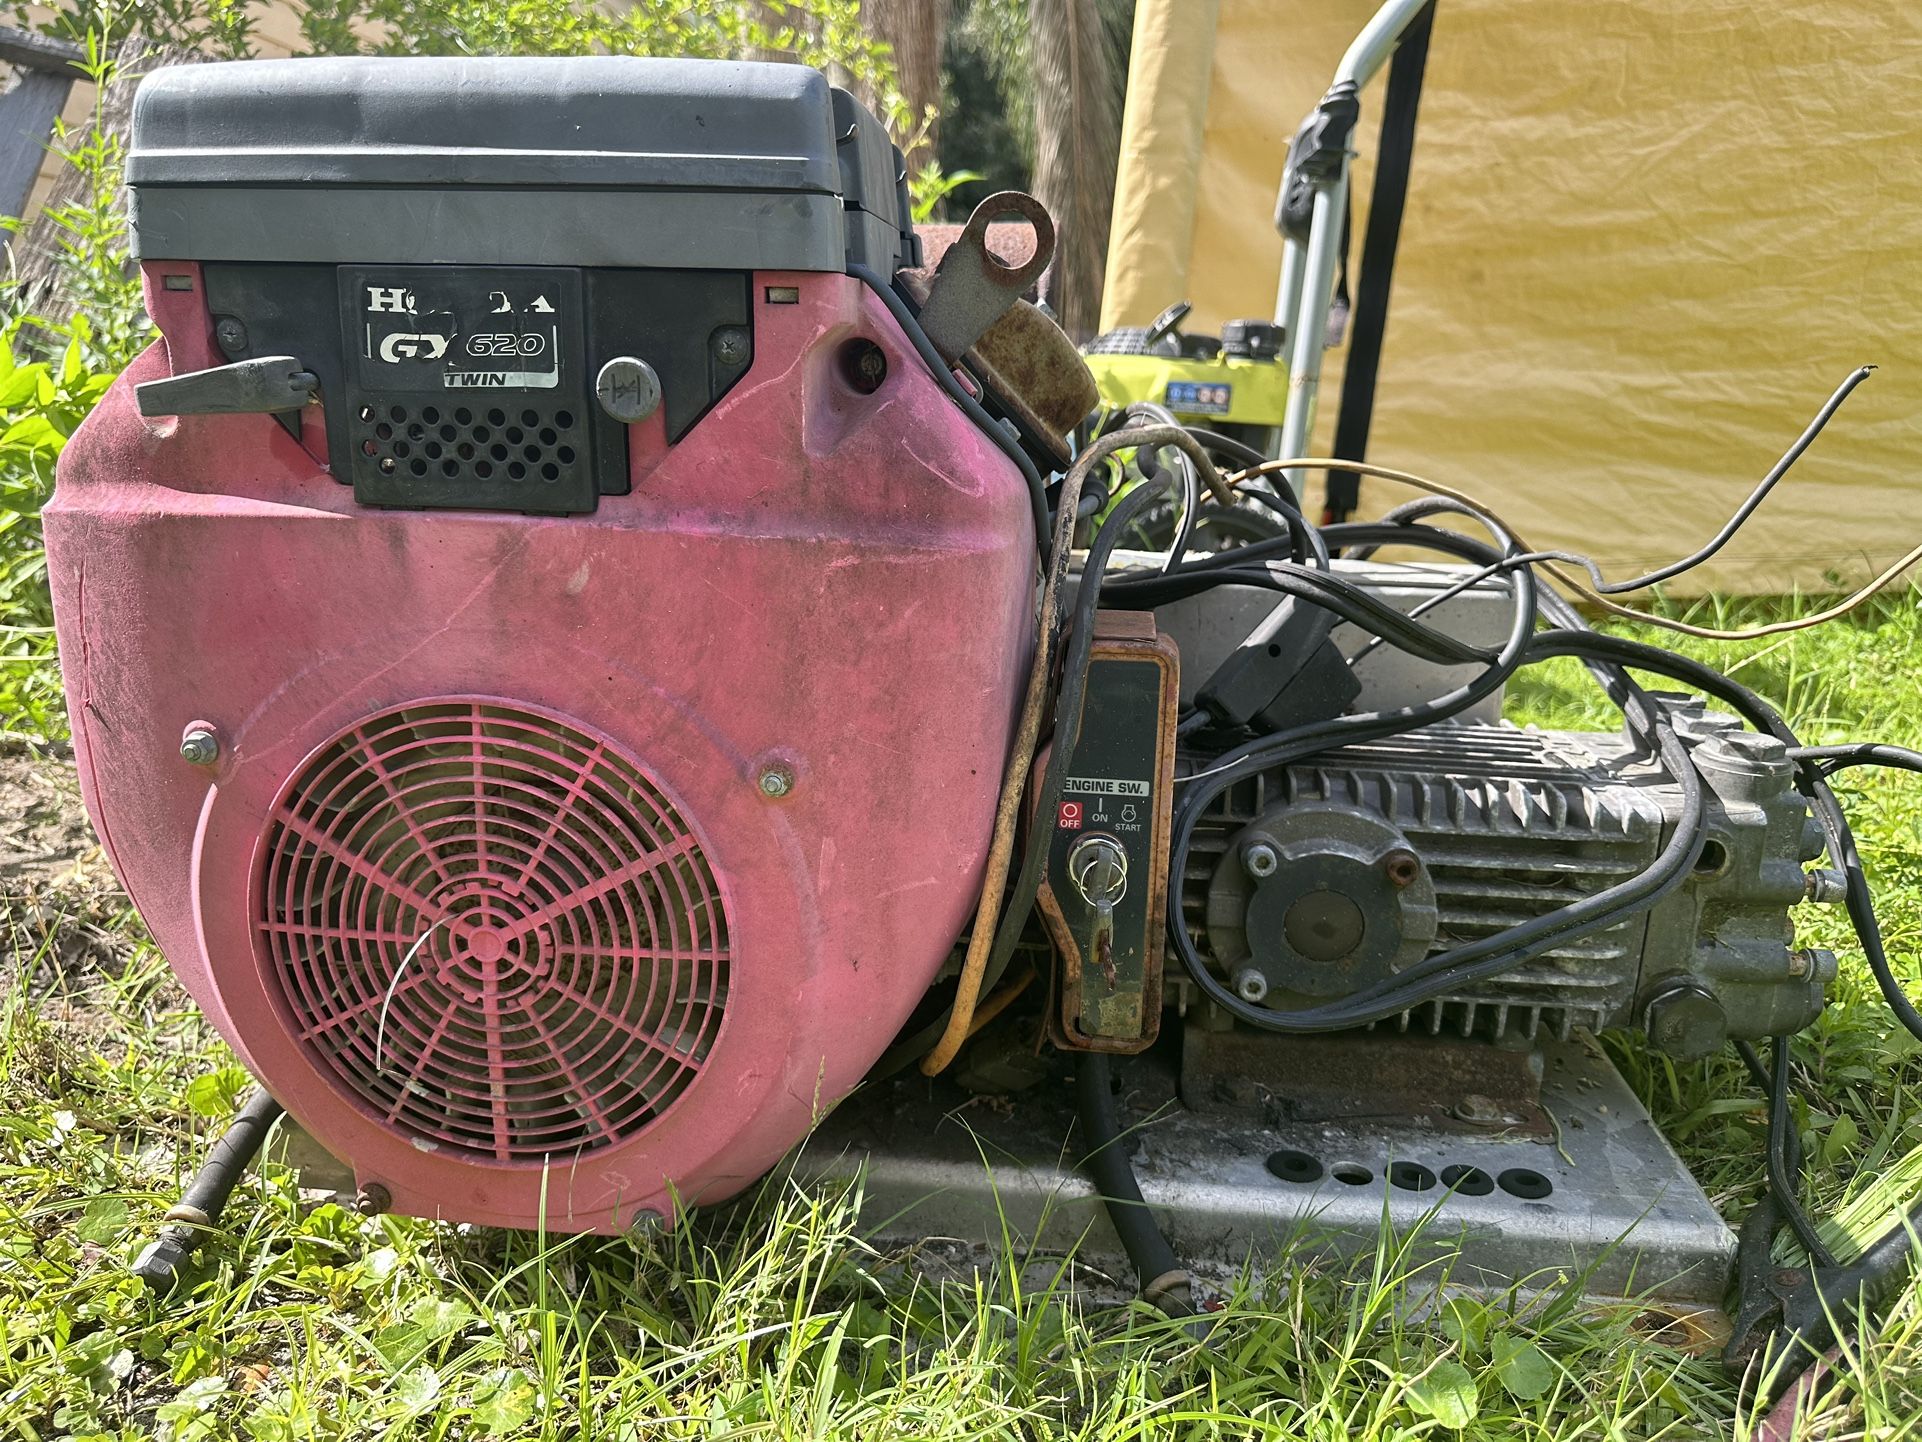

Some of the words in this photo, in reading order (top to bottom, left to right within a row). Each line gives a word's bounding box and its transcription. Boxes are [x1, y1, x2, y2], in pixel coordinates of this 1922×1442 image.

[466, 333, 546, 357] 620
[445, 373, 507, 386] TWIN
[1064, 780, 1113, 792] ENGINE
[1118, 782, 1143, 794] SW.
[1092, 813, 1108, 822] ON
[1060, 819, 1080, 828] OFF
[1115, 823, 1141, 832] START
